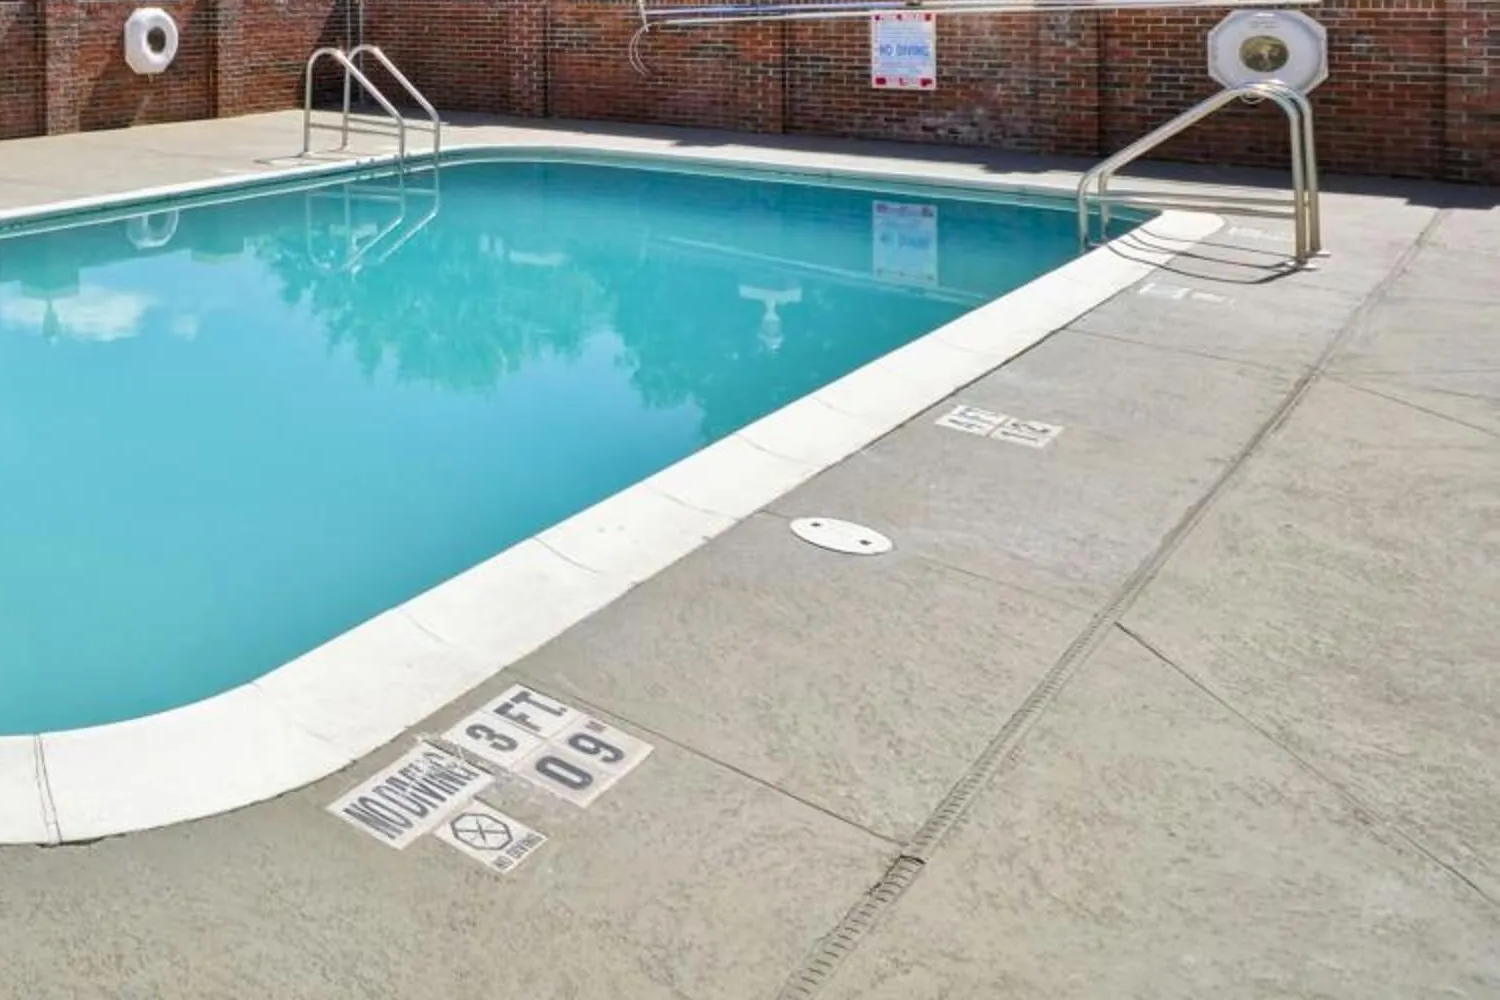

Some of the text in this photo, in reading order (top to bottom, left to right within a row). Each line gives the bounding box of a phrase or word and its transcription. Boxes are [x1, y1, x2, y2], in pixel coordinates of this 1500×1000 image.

[466, 723, 518, 751] 3
[342, 751, 480, 840] NO DIVING
